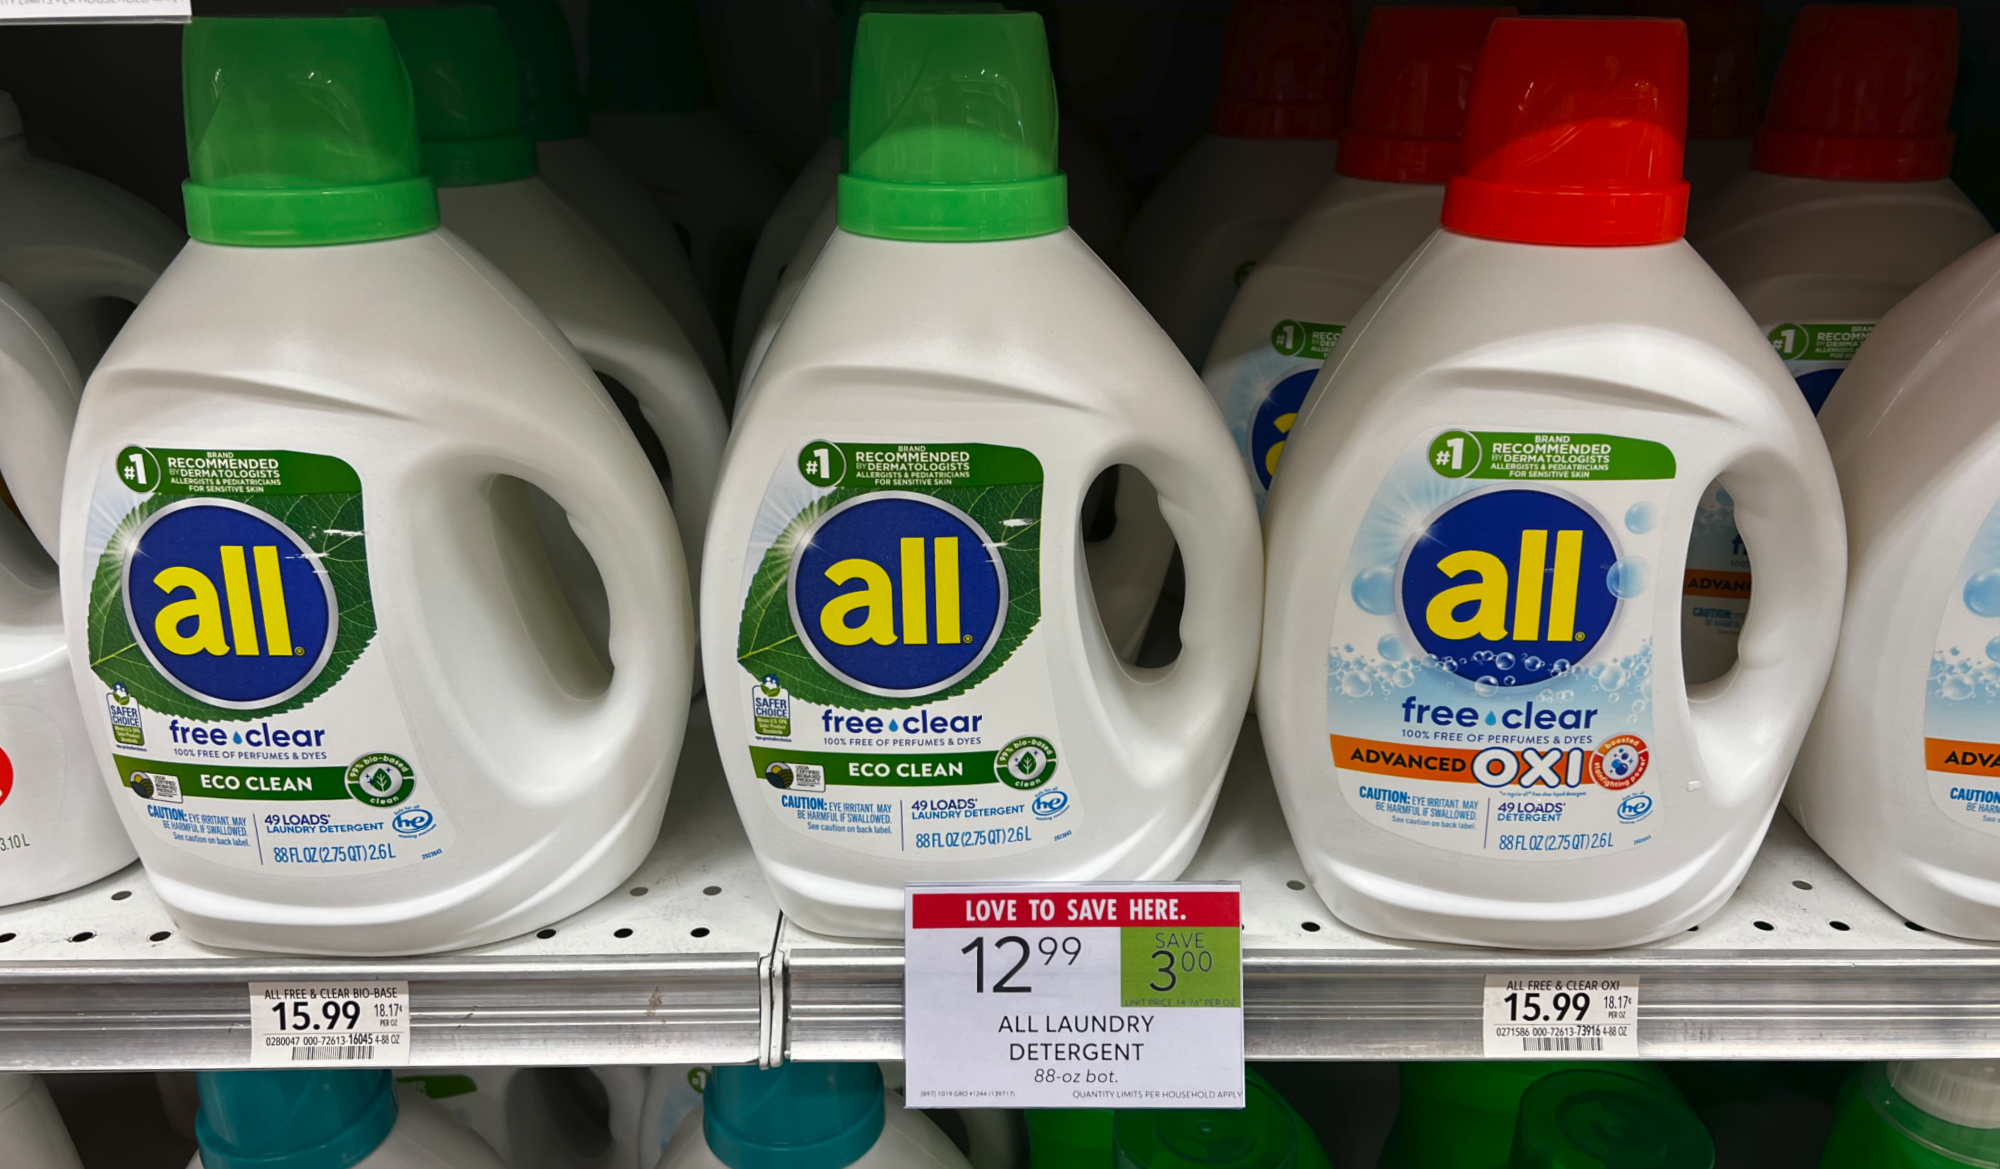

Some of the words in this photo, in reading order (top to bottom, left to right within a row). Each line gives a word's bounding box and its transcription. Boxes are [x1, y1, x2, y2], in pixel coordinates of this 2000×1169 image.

[1535, 435, 1570, 443] BRAND
[1436, 438, 1464, 469] #1
[1492, 443, 1611, 454] RECOMMENDED
[168, 458, 278, 469] RECOMMENDED
[806, 449, 830, 478] #1
[856, 452, 969, 462] RECOMMENDED
[1504, 454, 1610, 463] DERMATOLOGISTS
[124, 454, 147, 484] #1
[180, 469, 280, 478] DERMATOLOGISTS
[868, 463, 969, 471] DERMATOLOGISTS
[1528, 470, 1569, 478] SENSITIVE
[756, 698, 787, 709] SAFER
[111, 705, 138, 717] SAFER
[756, 707, 787, 718] CHOICE
[1402, 696, 1479, 727] free
[1502, 701, 1598, 729] clear
[112, 715, 139, 726] CHOICE
[822, 709, 884, 734] free
[903, 710, 982, 734] clear
[169, 720, 227, 745] free
[246, 723, 325, 747] clear
[1402, 729, 1429, 739] 100%
[1434, 732, 1462, 741] FREE
[1467, 734, 1484, 742] OF
[1488, 735, 1549, 744] PERFUMES
[1564, 735, 1592, 744] DYES
[824, 738, 846, 746] 100%
[957, 737, 981, 745] DYES
[1013, 739, 1052, 756] bio-based
[1604, 737, 1639, 749] boosted
[174, 749, 195, 757] 100%
[198, 750, 220, 758] FREE
[238, 751, 289, 759] PERFUMES
[363, 755, 409, 772] bio-based
[849, 763, 890, 777] ECO
[896, 762, 963, 777] CLEAN
[1350, 748, 1466, 772] ADVANCED
[1471, 747, 1584, 788] OXI
[200, 774, 240, 790] ECO
[246, 776, 312, 791] CLEAN
[1015, 779, 1041, 788] clean
[370, 796, 399, 804] clean
[782, 795, 827, 810] CAUTION:
[877, 804, 892, 813] MAY
[1359, 786, 1410, 804] CAUTION:
[1462, 800, 1479, 810] MAY
[912, 800, 927, 811] 49
[1387, 803, 1421, 816] HARMFUL
[1430, 808, 1477, 820] SWALLOWED.
[1498, 802, 1514, 812] 49
[1966, 803, 1976, 812] BE
[147, 804, 188, 820] CAUTION:
[232, 817, 246, 826] MAY
[807, 811, 838, 822] HARMFUL
[847, 814, 892, 824] SWALLOWED.
[912, 811, 962, 820] LAUNDRY
[964, 805, 1024, 818] DETERGENT
[1498, 813, 1562, 822] DETERGENT
[264, 814, 280, 825] 49
[172, 821, 199, 833] HARMFUL
[207, 826, 248, 836] SWALLOWED.
[267, 825, 317, 834] LAUNDRY
[319, 822, 384, 833] DETERGENT
[916, 833, 930, 848] 88
[946, 832, 959, 847] OZ
[1008, 827, 1024, 842] 2.6
[1499, 835, 1514, 850] 88
[1530, 835, 1543, 850] OZ
[1591, 833, 1606, 848] 2.6
[273, 848, 289, 862] 88
[306, 847, 319, 862] OZ
[966, 900, 1017, 922] LOVE
[1029, 899, 1055, 921] TO
[1067, 899, 1116, 920] SAVE
[1130, 898, 1187, 920] HERE.
[1155, 933, 1204, 949] SAVE
[1507, 981, 1524, 990] ALL
[1528, 981, 1552, 990] FREE
[1566, 981, 1598, 990] CLEAR
[1602, 981, 1619, 990] OXI
[265, 990, 281, 1000] ALL
[285, 989, 306, 999] FREE
[320, 989, 349, 998] CLEAR
[353, 988, 397, 998] BIO-BASE
[1504, 993, 1590, 1021] 15.99
[272, 1001, 360, 1030] 15.99
[998, 1015, 1038, 1032] ALL
[1046, 1015, 1154, 1032] LAUNDRY
[1496, 1027, 1529, 1036] 0271586
[1533, 1025, 1600, 1036] 000-72613-73916
[266, 1036, 299, 1046] 0280047
[303, 1033, 372, 1045] 000-72613-16045
[1009, 1043, 1144, 1060] DETERGENT
[1034, 1070, 1080, 1083] 88-oz
[1086, 1069, 1118, 1083] bot.
[1073, 1091, 1114, 1099] QUANTITY
